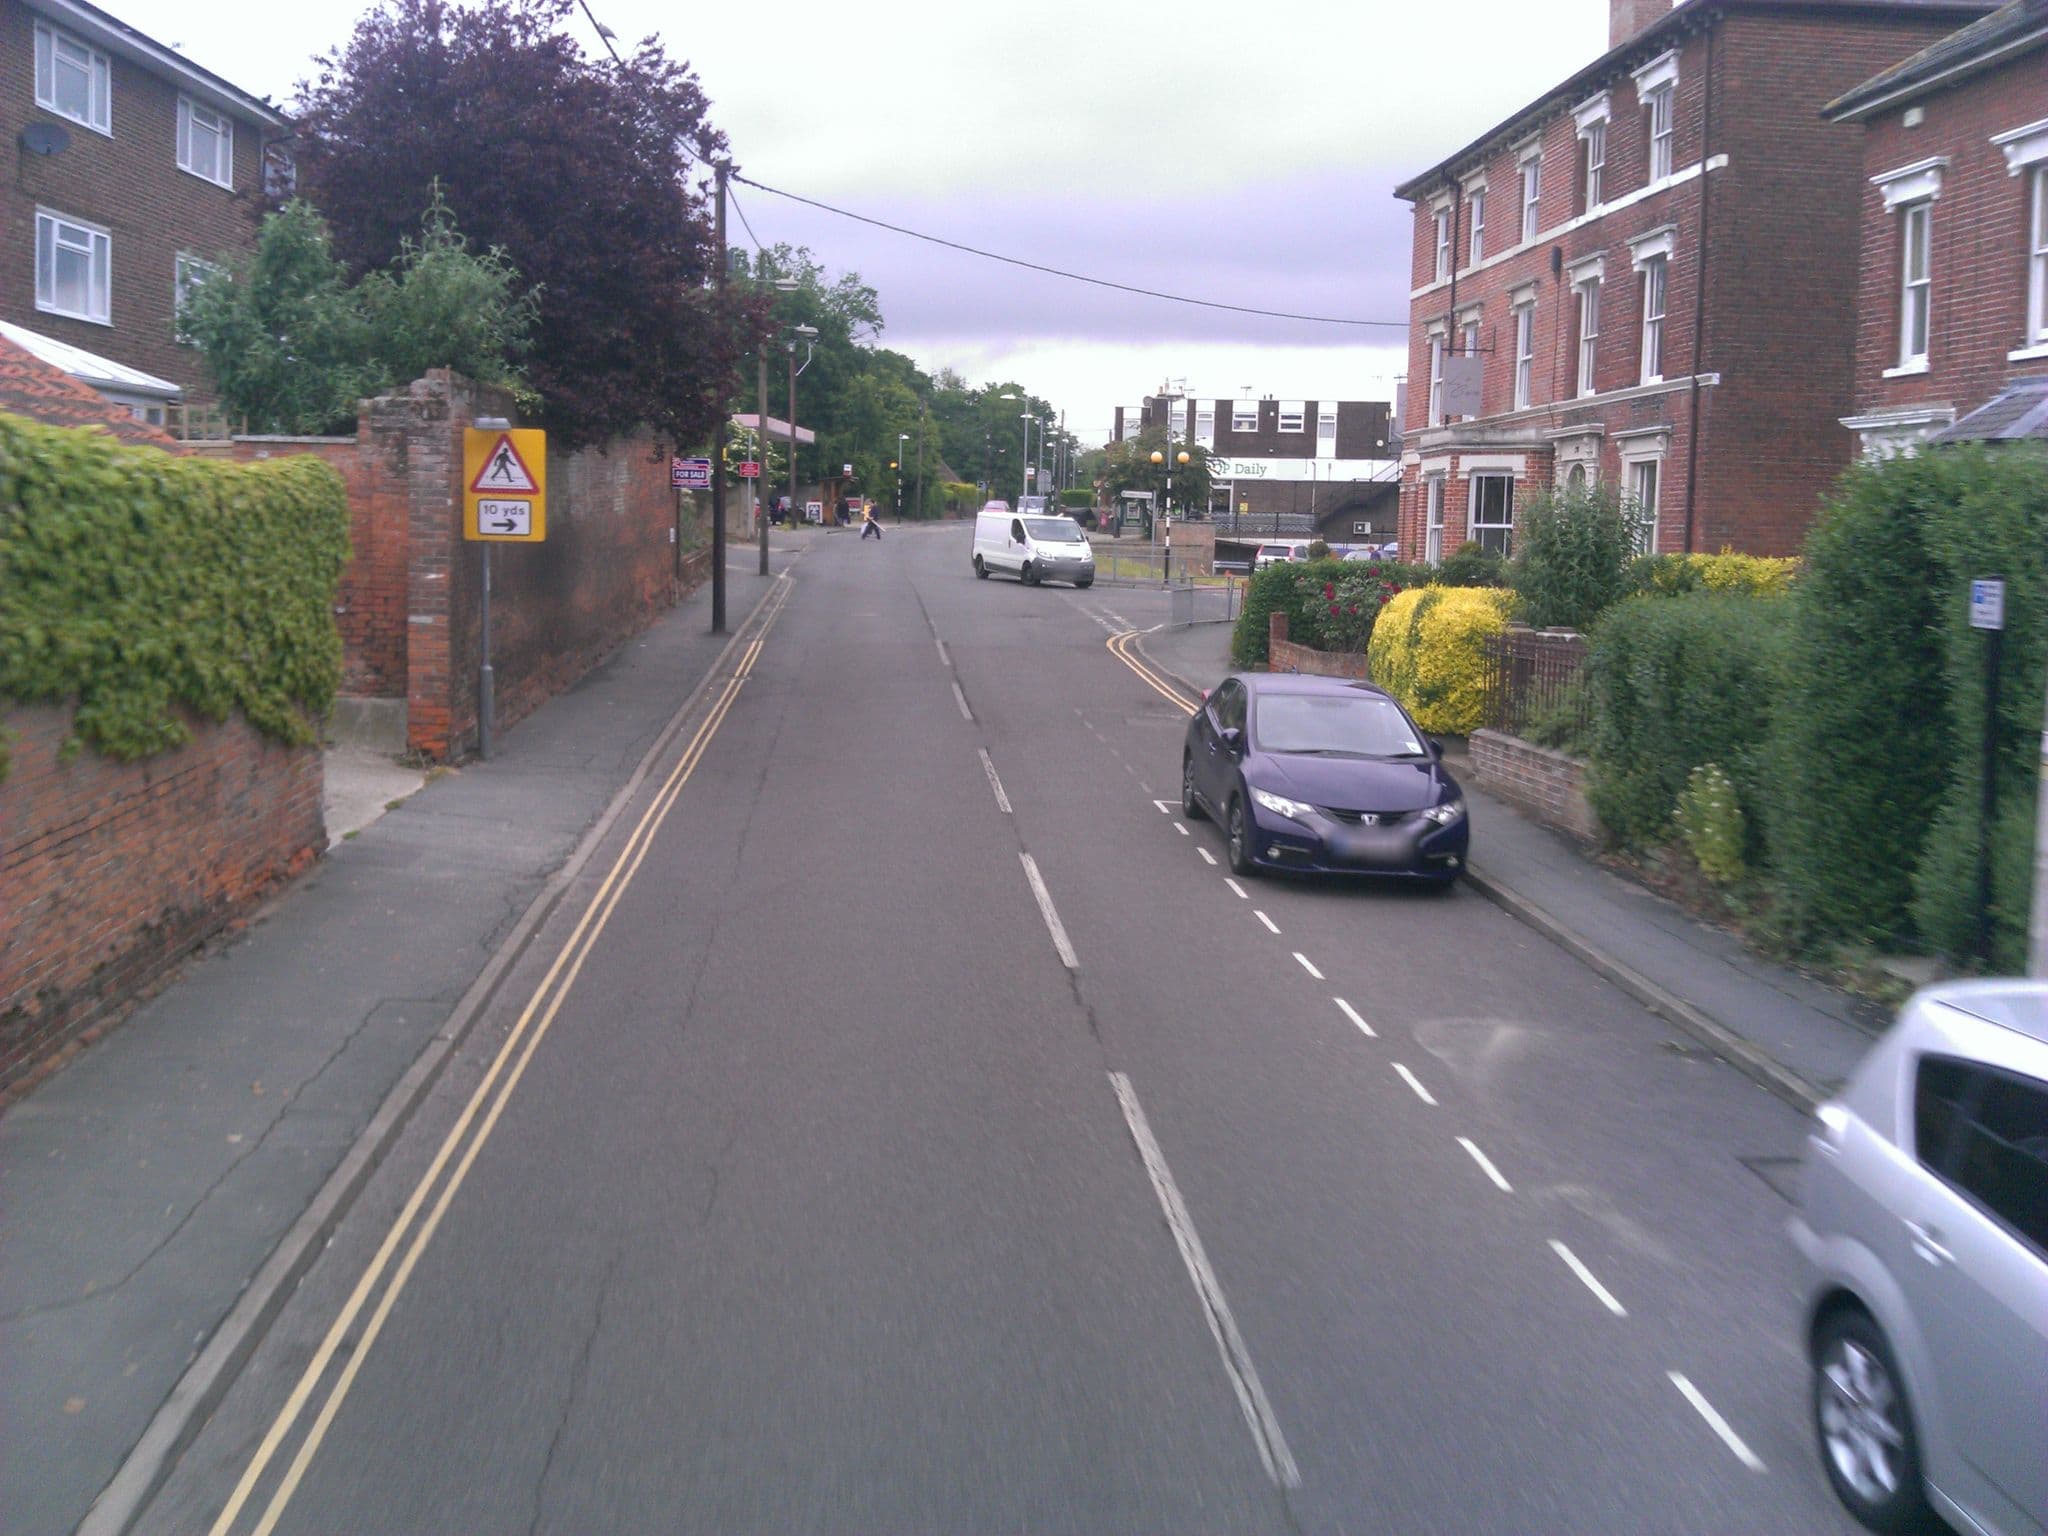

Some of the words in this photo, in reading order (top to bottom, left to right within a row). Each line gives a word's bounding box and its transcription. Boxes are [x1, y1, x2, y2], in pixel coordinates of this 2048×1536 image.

[676, 470, 689, 478] FOR
[1234, 463, 1268, 477] Daily
[483, 504, 498, 515] 10
[503, 505, 525, 517] yds
